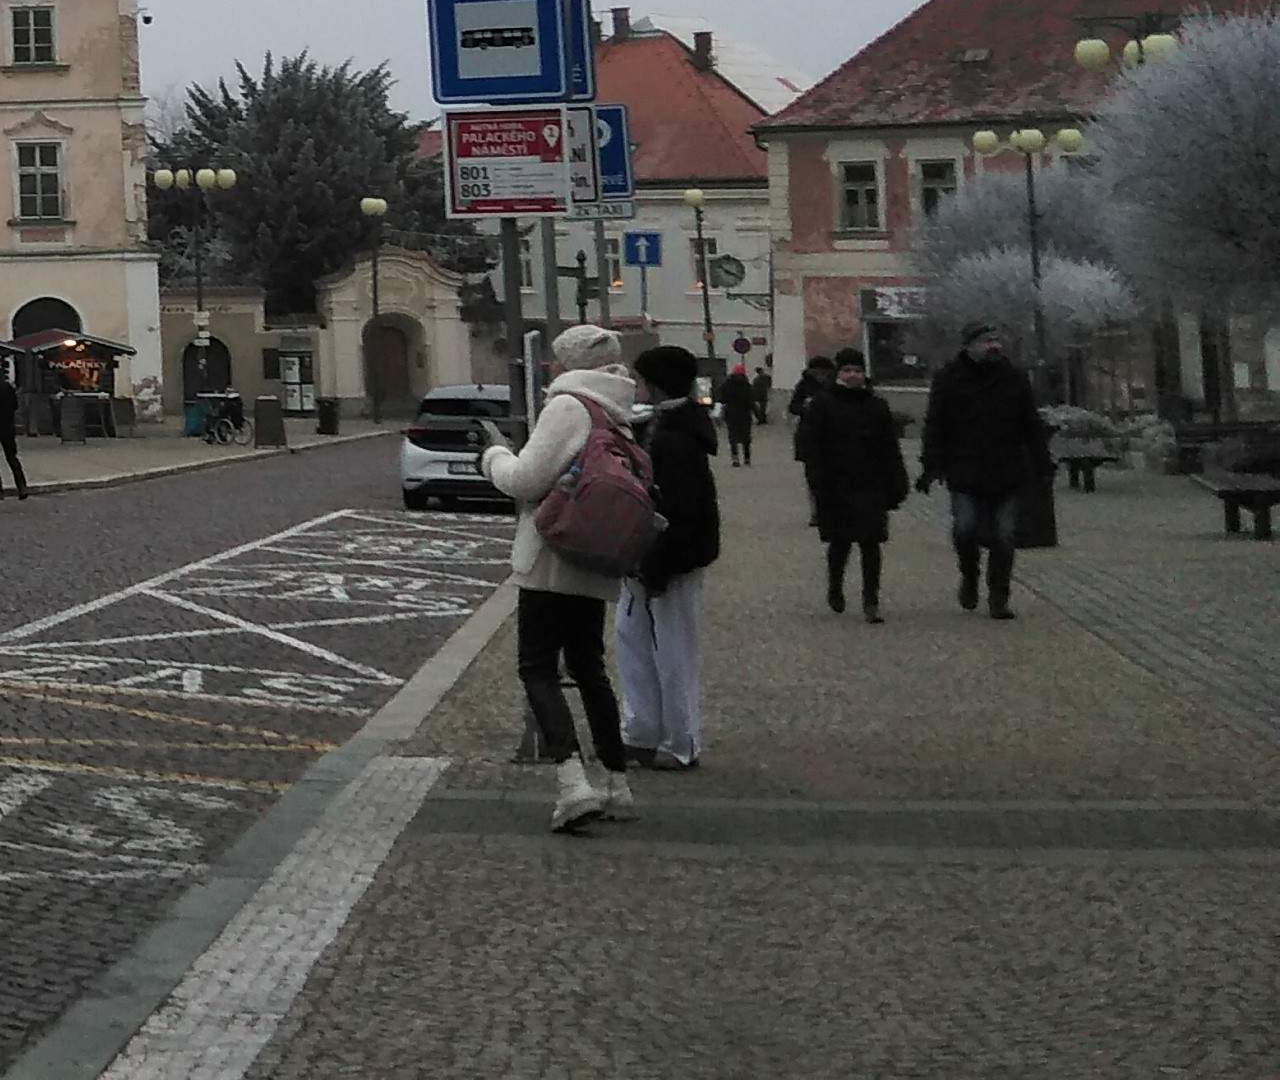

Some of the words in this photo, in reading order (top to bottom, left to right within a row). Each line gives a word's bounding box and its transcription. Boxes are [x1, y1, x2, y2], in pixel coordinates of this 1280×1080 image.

[461, 129, 537, 143] PALACKÉHO
[471, 143, 529, 156] NÁMĚSTÍ
[460, 166, 490, 180] 801
[461, 183, 492, 198] 803
[596, 204, 623, 215] TAXI
[48, 359, 107, 370] PALAČINKY
